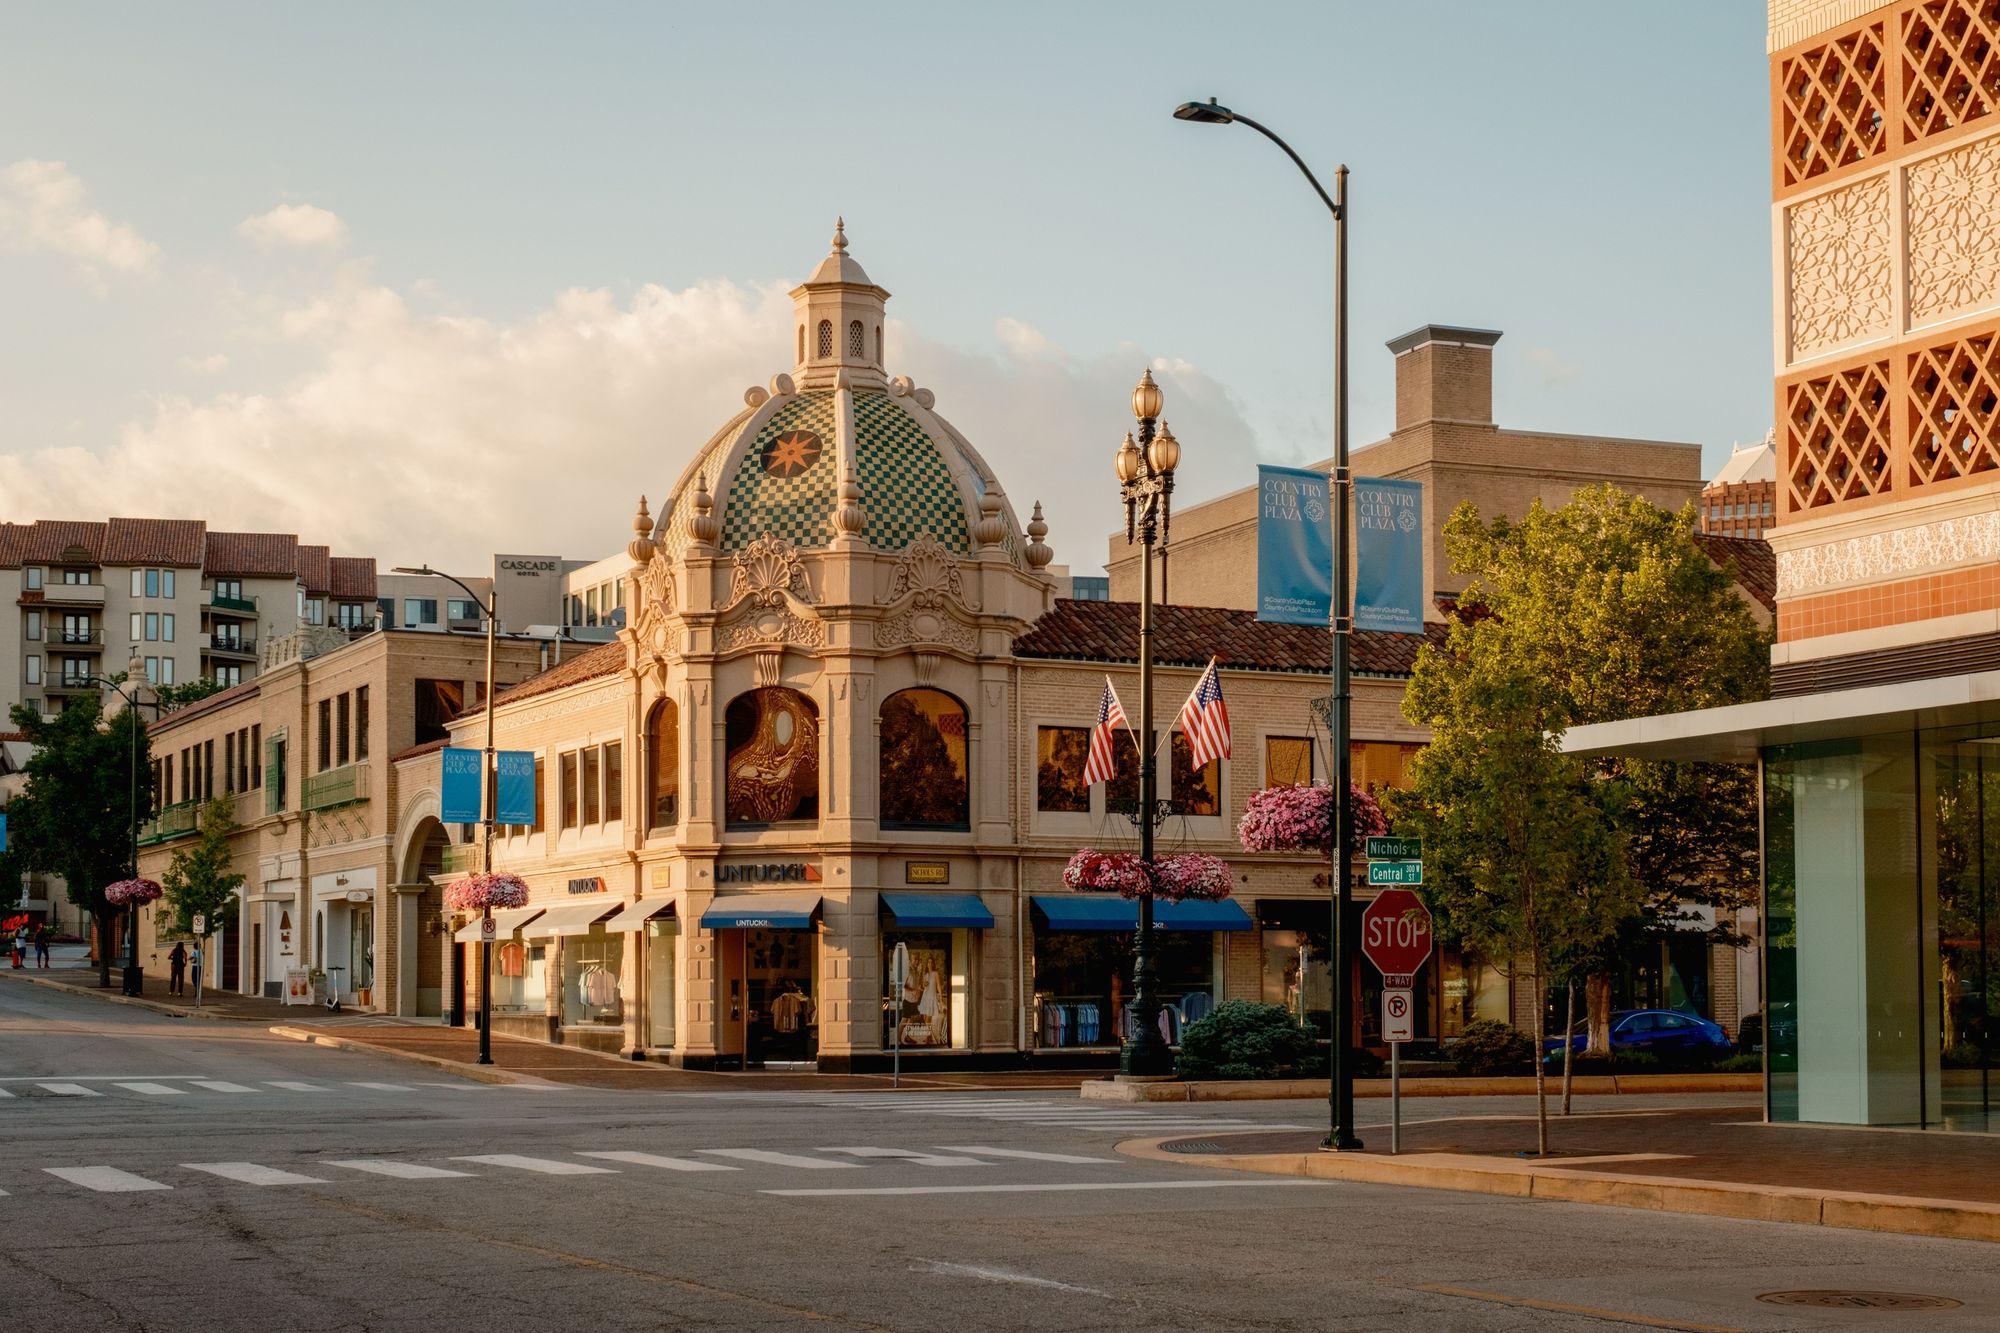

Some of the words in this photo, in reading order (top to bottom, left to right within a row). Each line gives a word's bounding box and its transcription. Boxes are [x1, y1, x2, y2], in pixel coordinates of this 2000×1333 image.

[1264, 479, 1323, 498] COUNTRY
[1264, 492, 1297, 507] CLUB
[1360, 490, 1416, 508] COUNTRY
[1264, 505, 1303, 522] PLAZA
[1360, 503, 1391, 517] CLUB
[1360, 516, 1396, 532] PLAZA
[500, 560, 556, 571] CASCADE
[1370, 841, 1408, 855] Nichols
[1373, 867, 1403, 880] Central
[1405, 864, 1416, 873] 300
[1408, 873, 1415, 881] ST
[1368, 916, 1427, 947] STOP
[1386, 976, 1410, 985] 4-WAY
